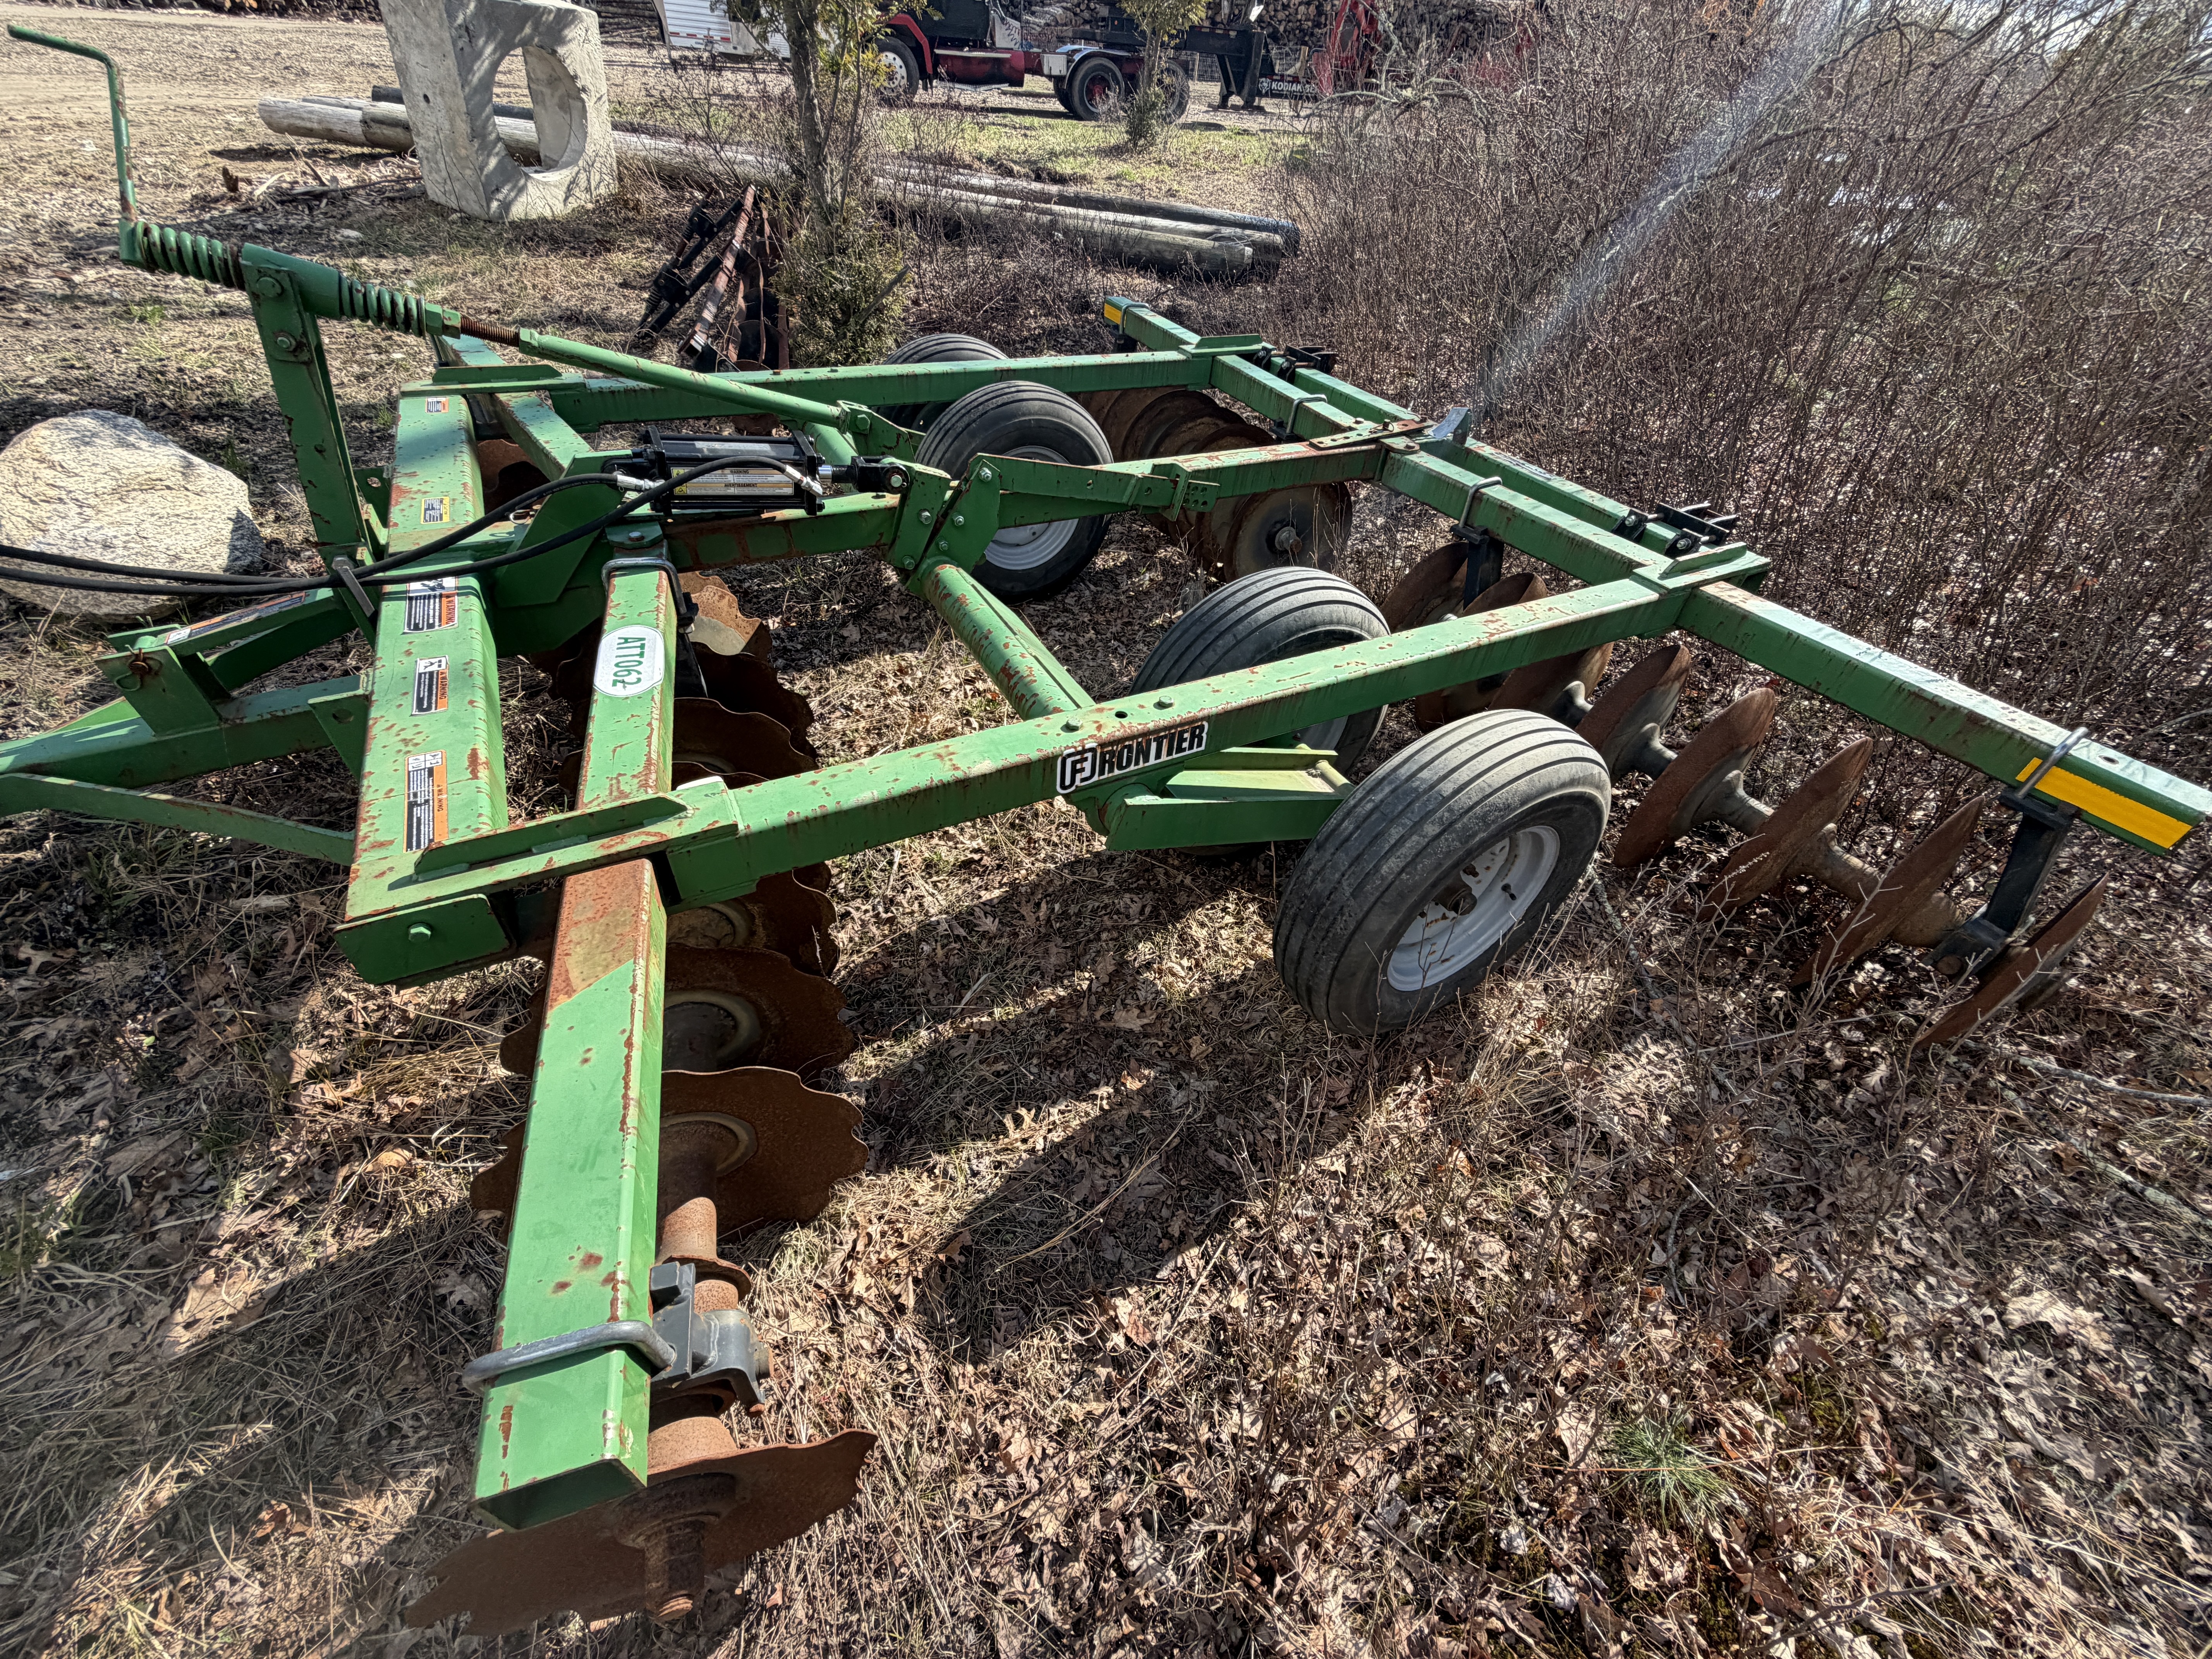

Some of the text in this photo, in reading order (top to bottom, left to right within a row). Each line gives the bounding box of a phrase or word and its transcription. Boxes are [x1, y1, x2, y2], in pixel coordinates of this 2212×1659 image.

[1271, 81, 1302, 92] KODIAK
[445, 599, 455, 625] WARNING
[611, 637, 646, 687] ATT062
[439, 676, 448, 700] WARNING
[1059, 723, 1206, 791] FRONTIER
